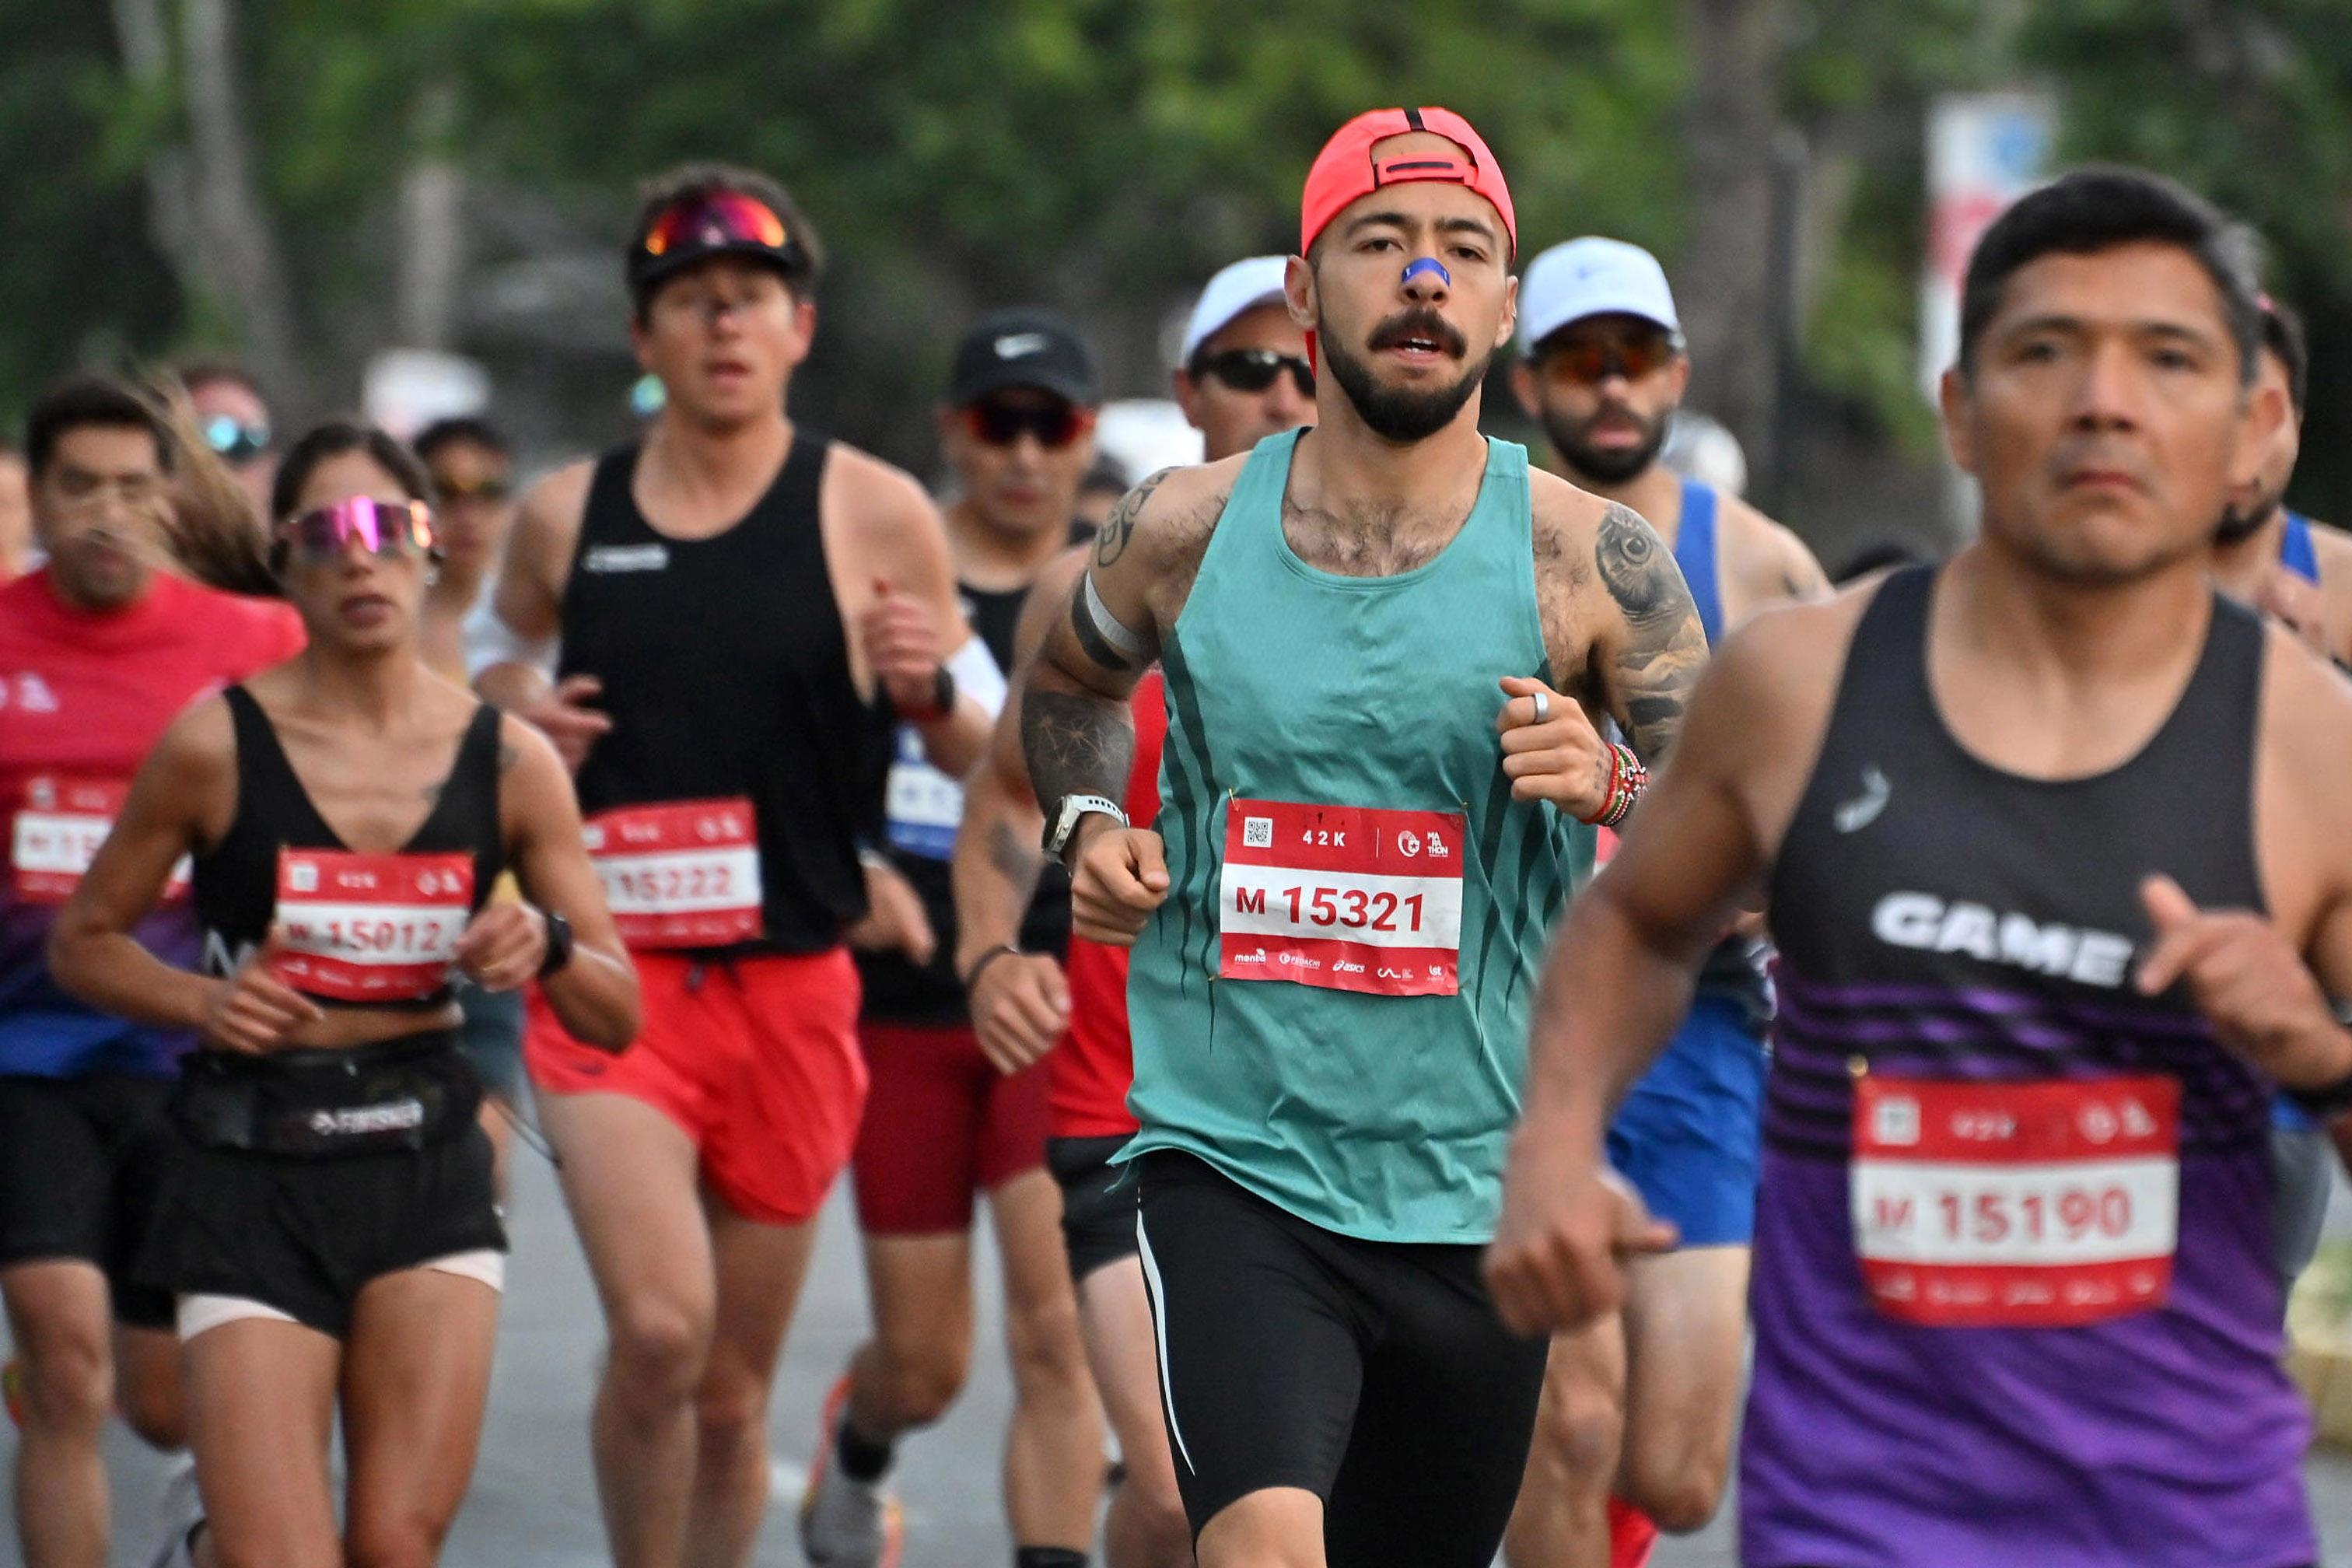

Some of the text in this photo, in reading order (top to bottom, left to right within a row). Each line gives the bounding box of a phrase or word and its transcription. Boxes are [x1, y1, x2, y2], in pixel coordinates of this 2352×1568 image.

[619, 865, 731, 903] 15222
[1236, 886, 1423, 932] M 15321
[327, 919, 441, 952] 15012
[1872, 891, 2134, 989] GAME
[1939, 1183, 2133, 1243] 15190
